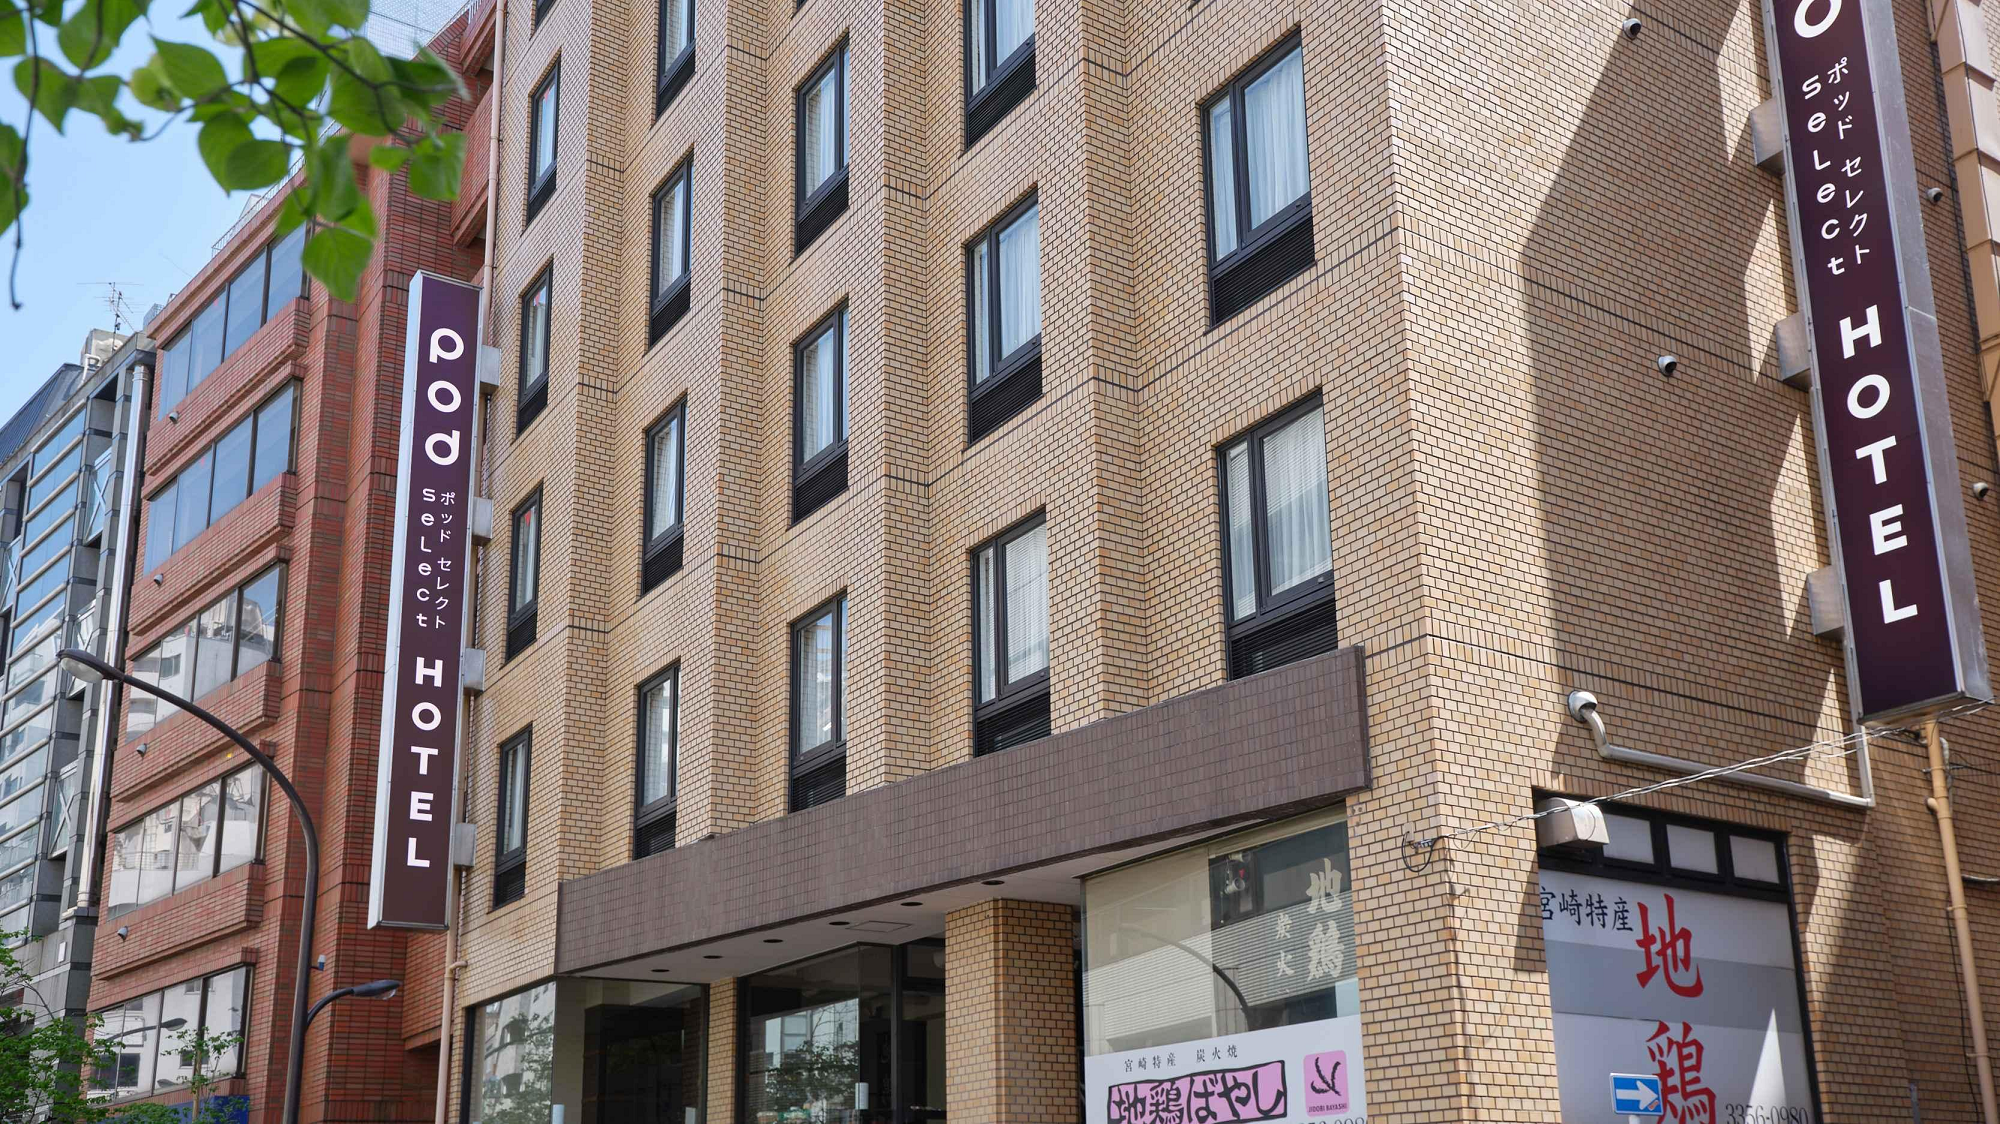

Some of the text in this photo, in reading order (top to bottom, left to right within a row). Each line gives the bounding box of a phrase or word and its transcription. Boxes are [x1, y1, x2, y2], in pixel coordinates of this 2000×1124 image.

[1827, 56, 1870, 265] ポッド セレクト
[424, 327, 465, 466] pod
[1838, 303, 1919, 625] HOTEL
[435, 491, 456, 629] ポッド セレクト
[406, 656, 444, 869] HOTEL
[1305, 857, 1345, 982] 地鶏
[1540, 885, 1634, 932] 宮崎特産
[1123, 1044, 1239, 1073] 宮崎特産 炭火焼
[1636, 893, 1717, 1124] 地鶏
[1110, 1069, 1285, 1124] 地鶏ばやし
[1725, 1102, 1809, 1124] 3356-0980
